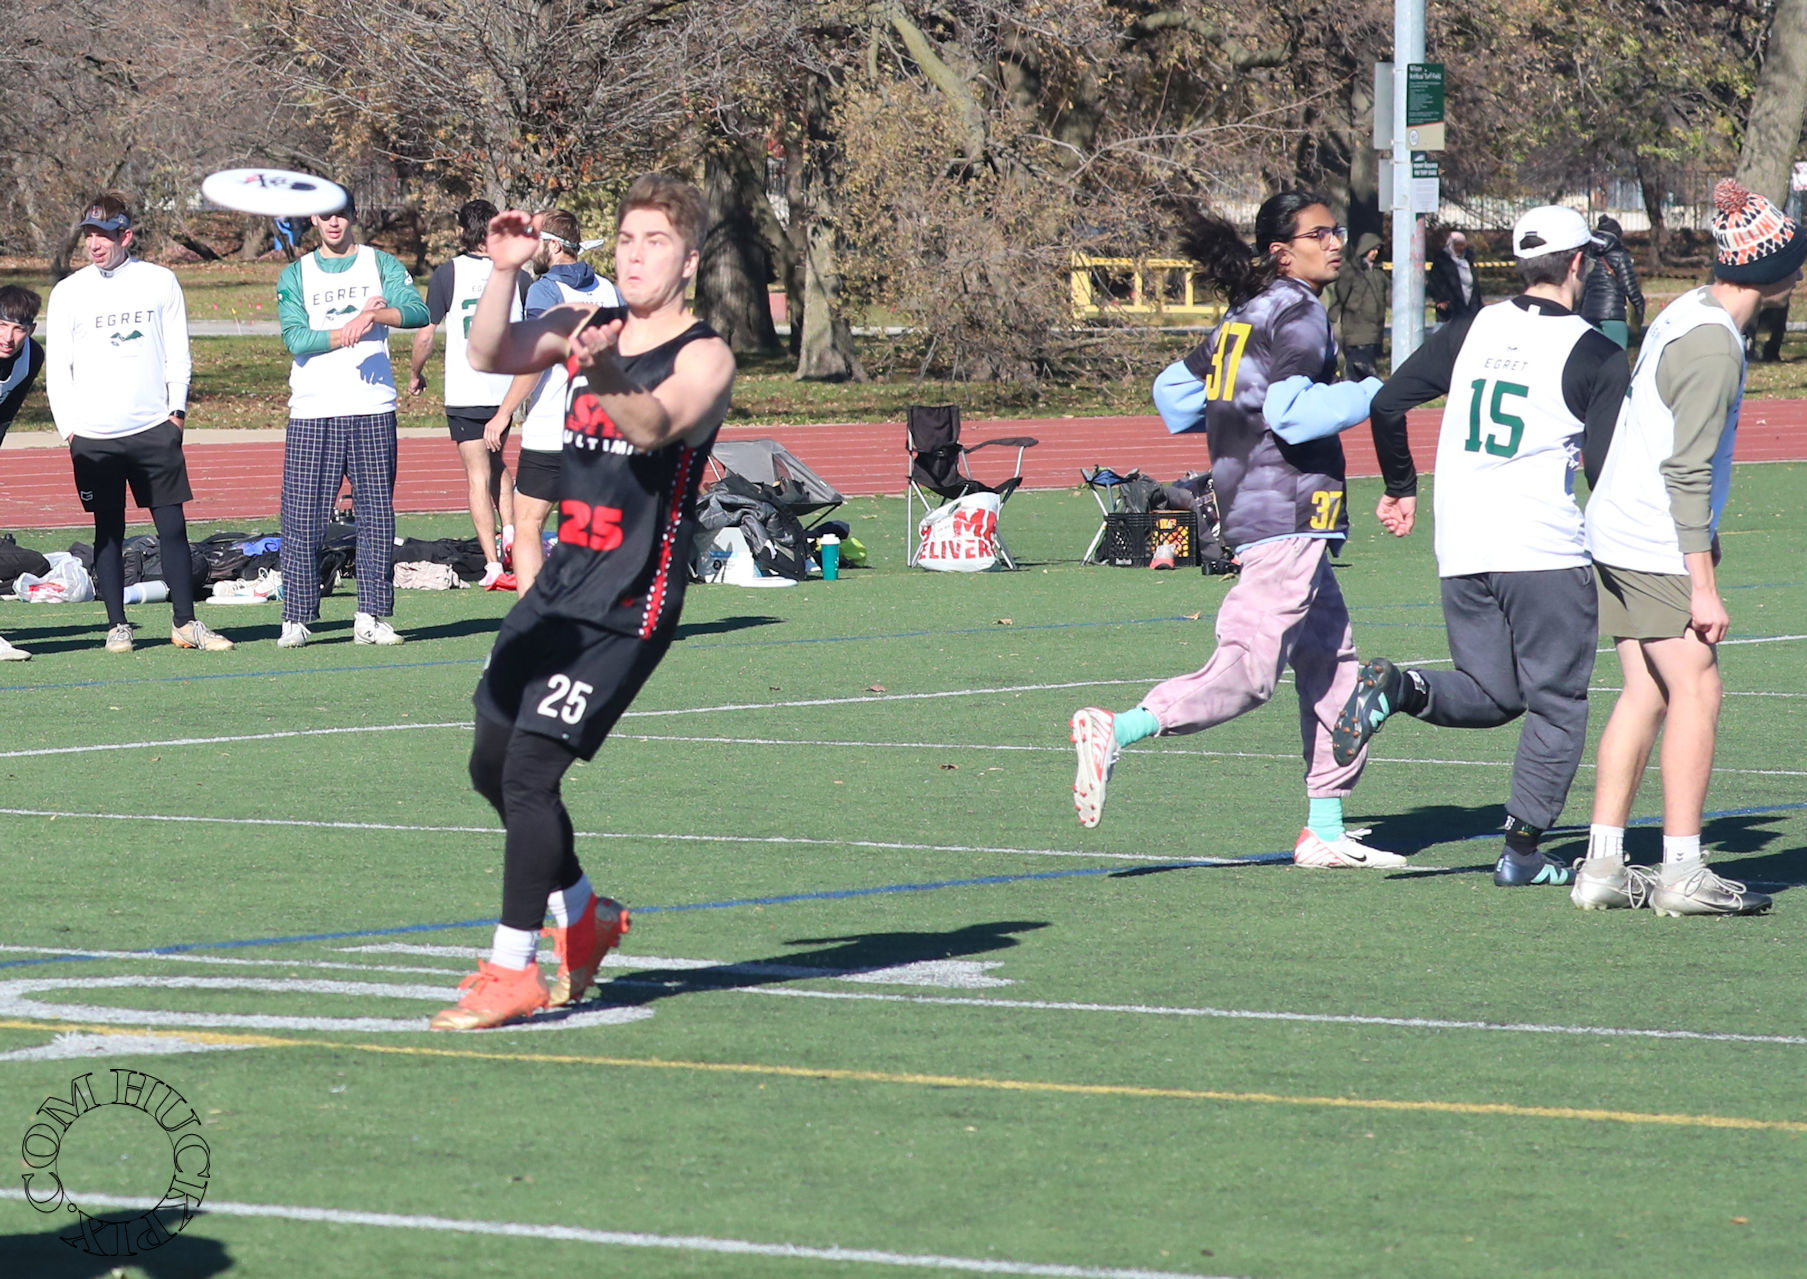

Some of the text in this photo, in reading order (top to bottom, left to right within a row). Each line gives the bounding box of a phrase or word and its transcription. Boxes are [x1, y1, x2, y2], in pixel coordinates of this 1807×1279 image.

[1731, 214, 1779, 248] ILLINI
[313, 286, 370, 306] EGRET
[95, 310, 155, 329] EGRET
[1206, 322, 1252, 401] 37
[1484, 358, 1529, 371] EGRET
[1464, 378, 1529, 459] 15
[558, 499, 625, 552] 25
[1310, 491, 1343, 530] 37
[919, 539, 997, 560] ELIVER
[536, 673, 594, 725] 25
